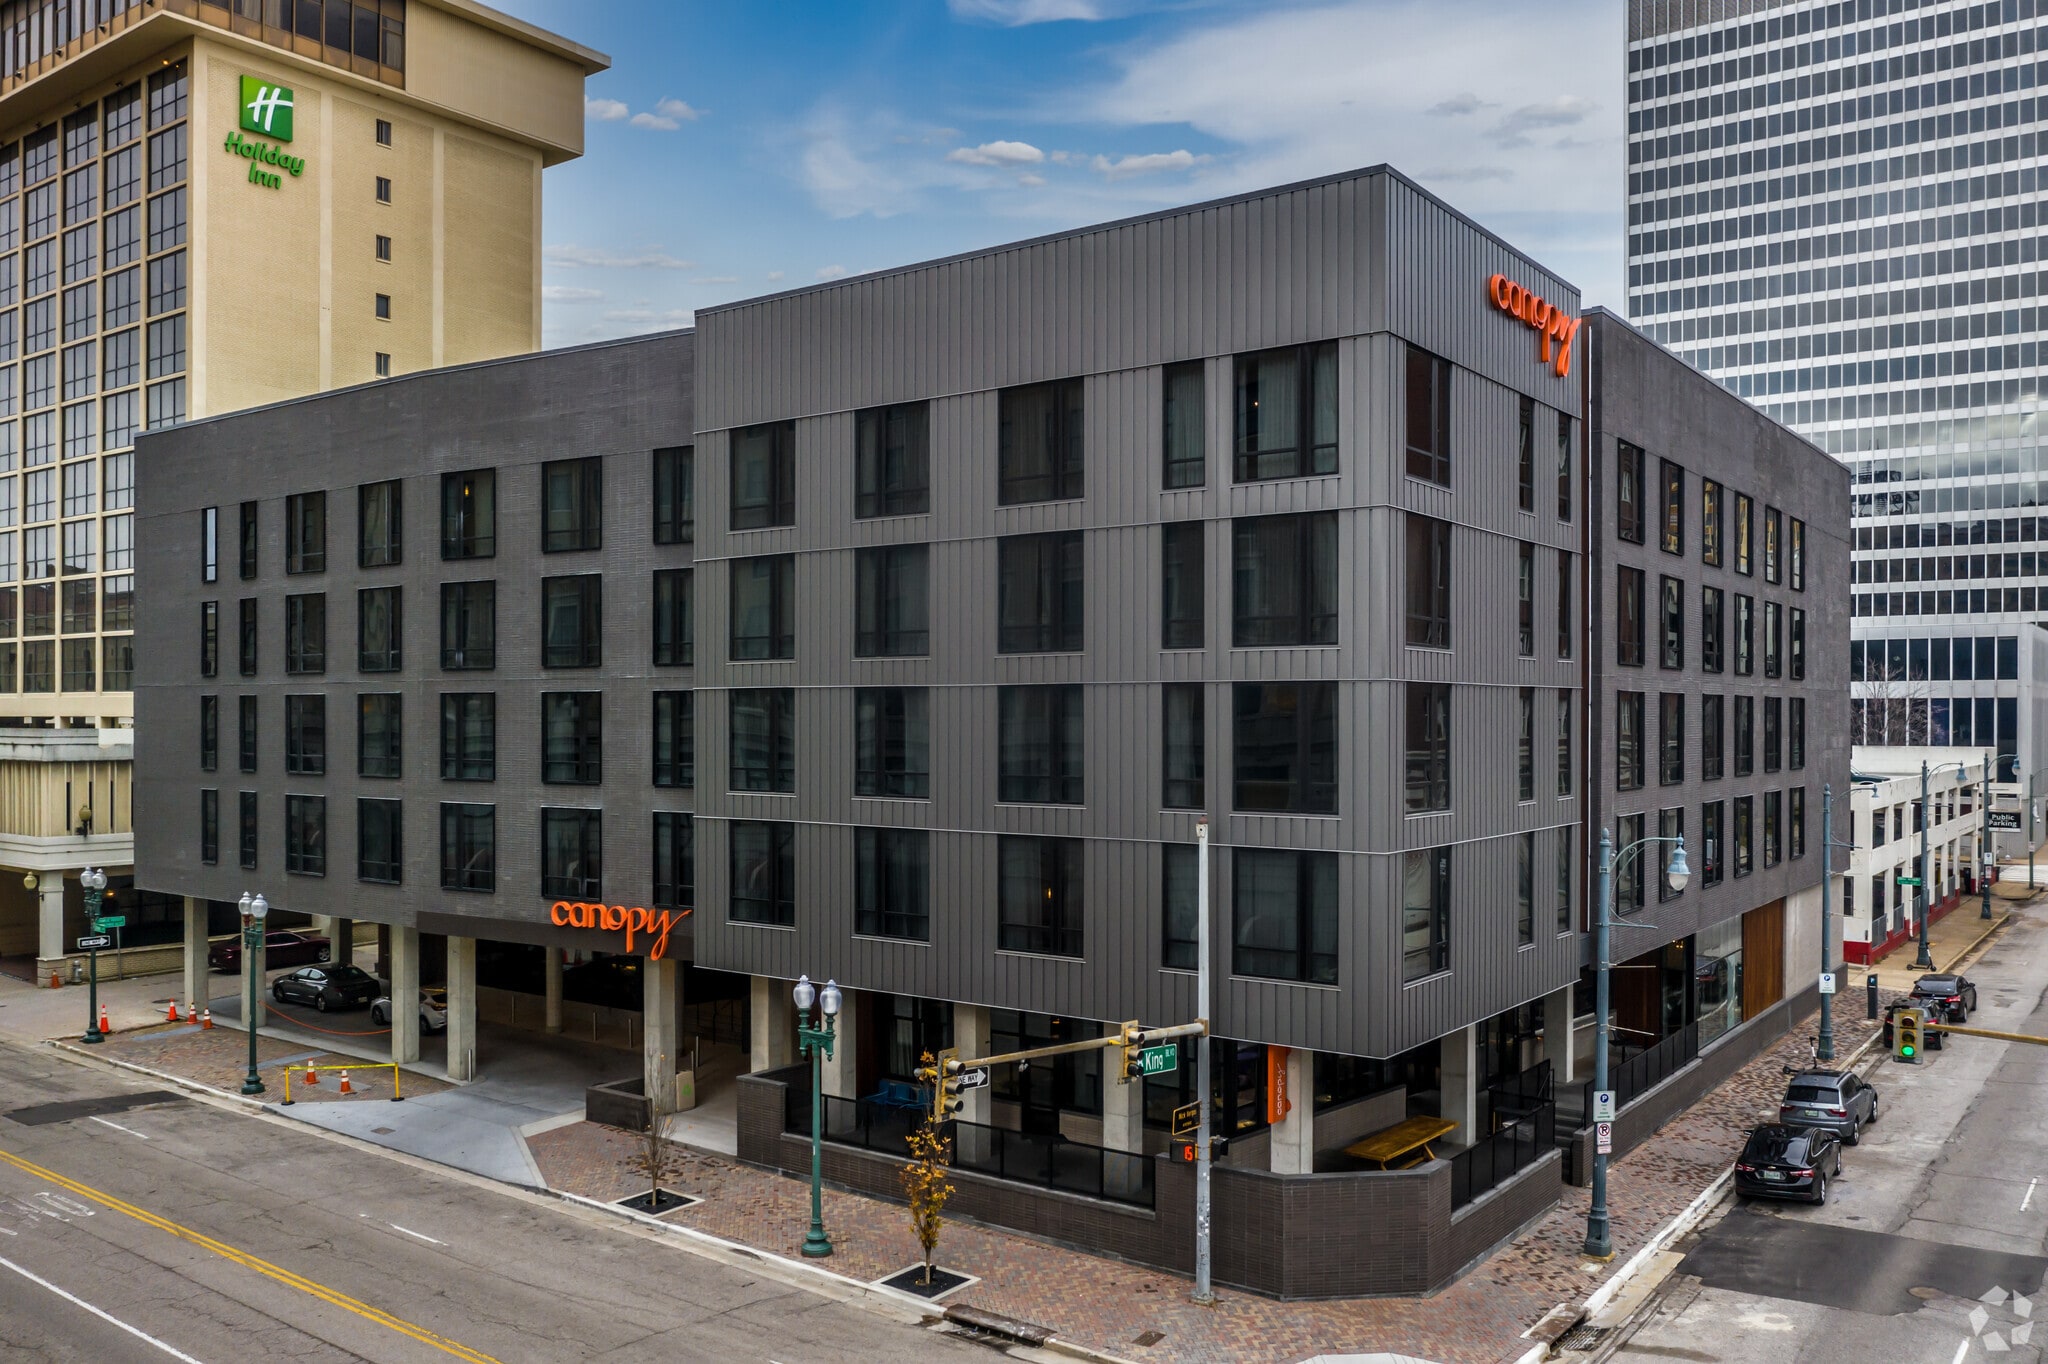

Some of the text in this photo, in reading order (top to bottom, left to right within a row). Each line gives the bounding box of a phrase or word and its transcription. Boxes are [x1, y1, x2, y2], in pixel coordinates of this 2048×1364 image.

[224, 131, 305, 177] Holiday
[248, 161, 282, 190] Inn
[1490, 274, 1582, 378] canopy
[1988, 820, 2017, 828] Parking
[550, 900, 692, 961] canopy
[1145, 1051, 1164, 1071] King
[1165, 1048, 1175, 1057] BLVD
[967, 1074, 978, 1083] WAY
[1277, 1063, 1286, 1116] canopy
